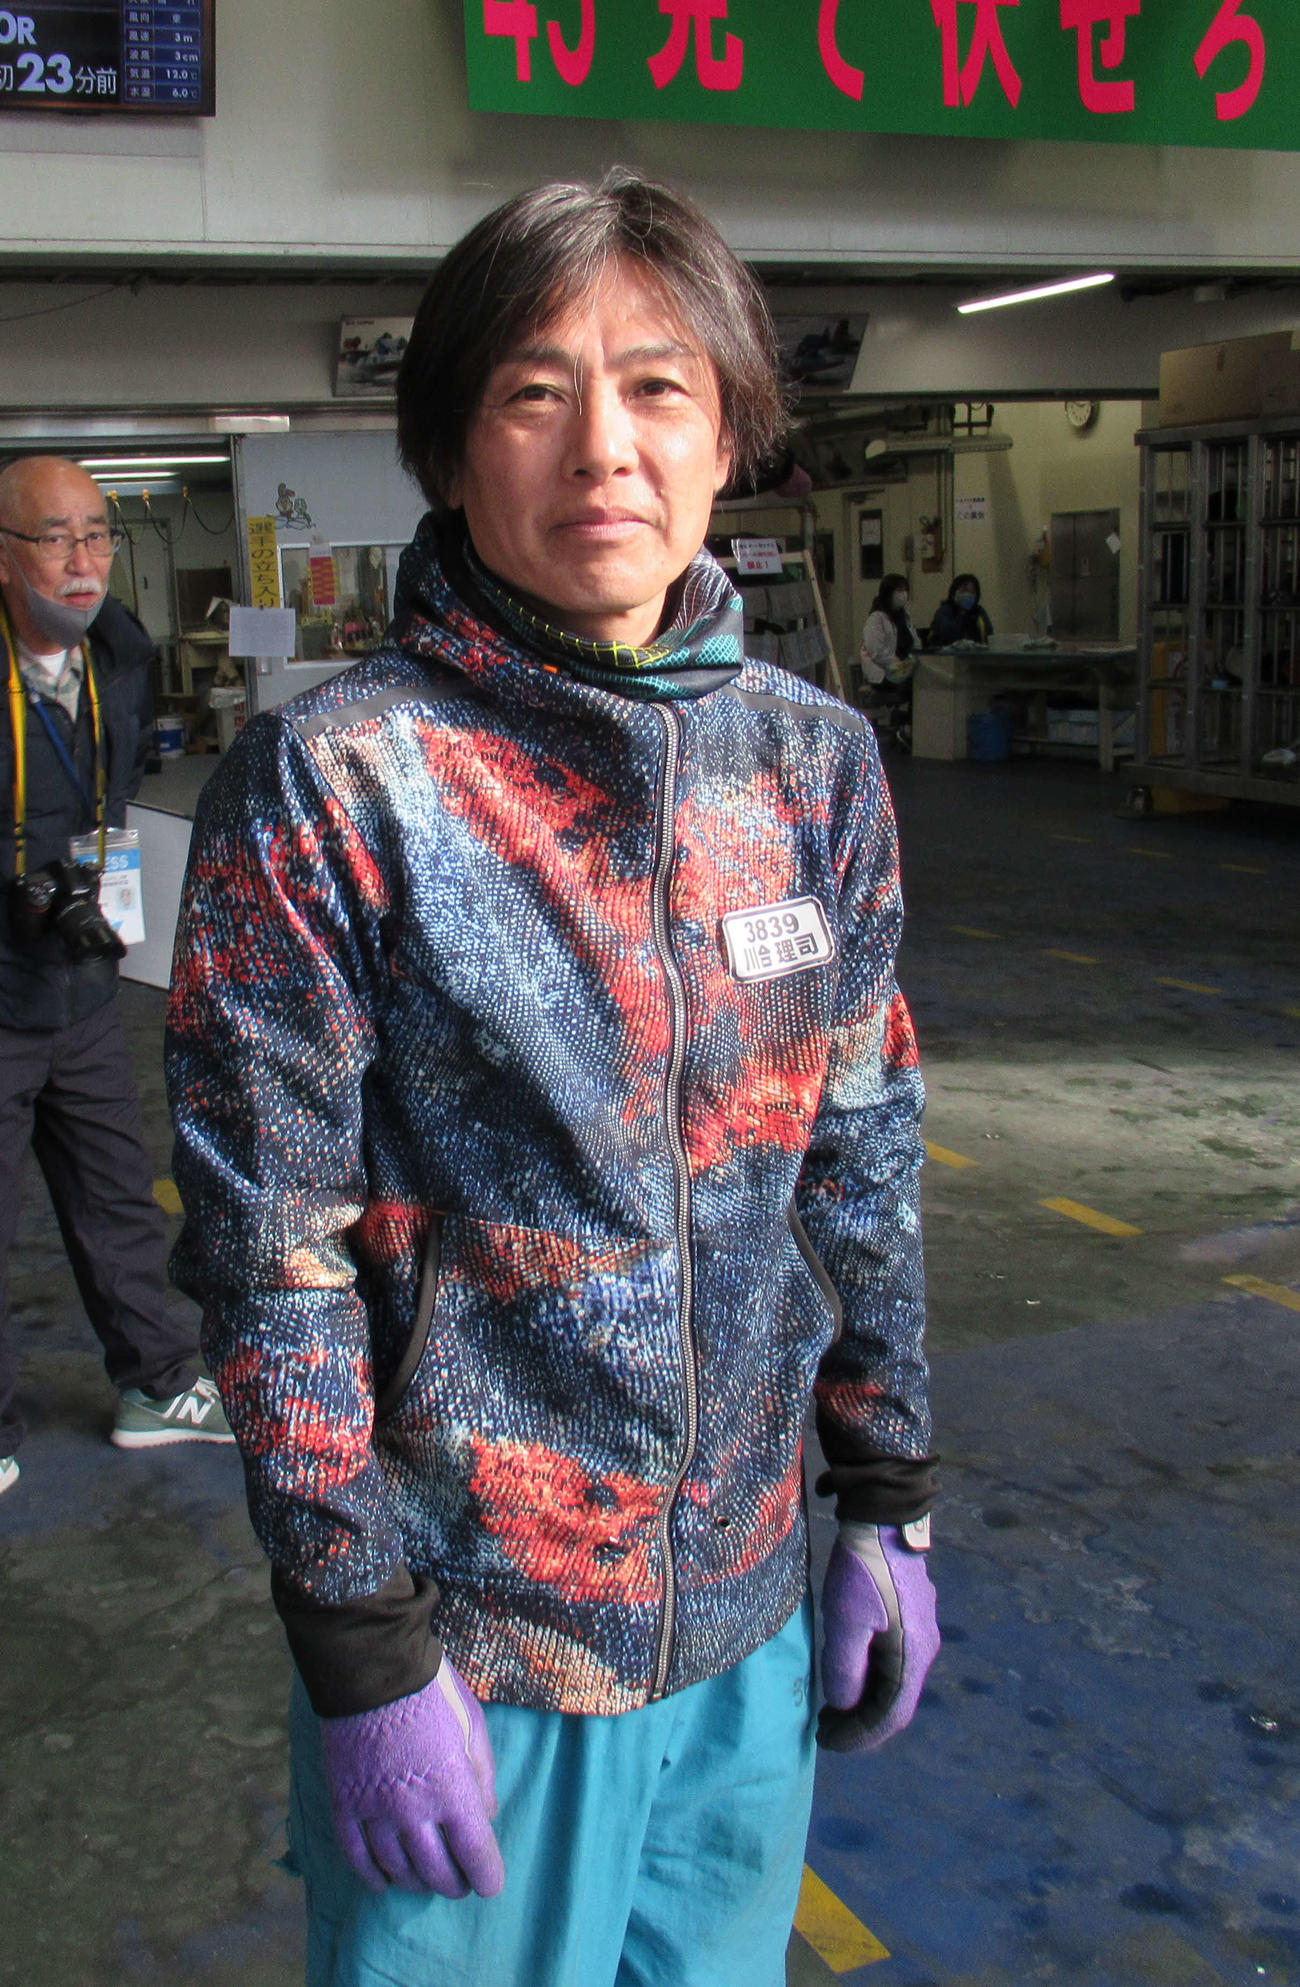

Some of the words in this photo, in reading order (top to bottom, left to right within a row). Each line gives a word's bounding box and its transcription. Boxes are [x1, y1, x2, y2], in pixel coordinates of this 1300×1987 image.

[744, 912, 800, 943] 3839
[744, 932, 819, 971] 川合理司
